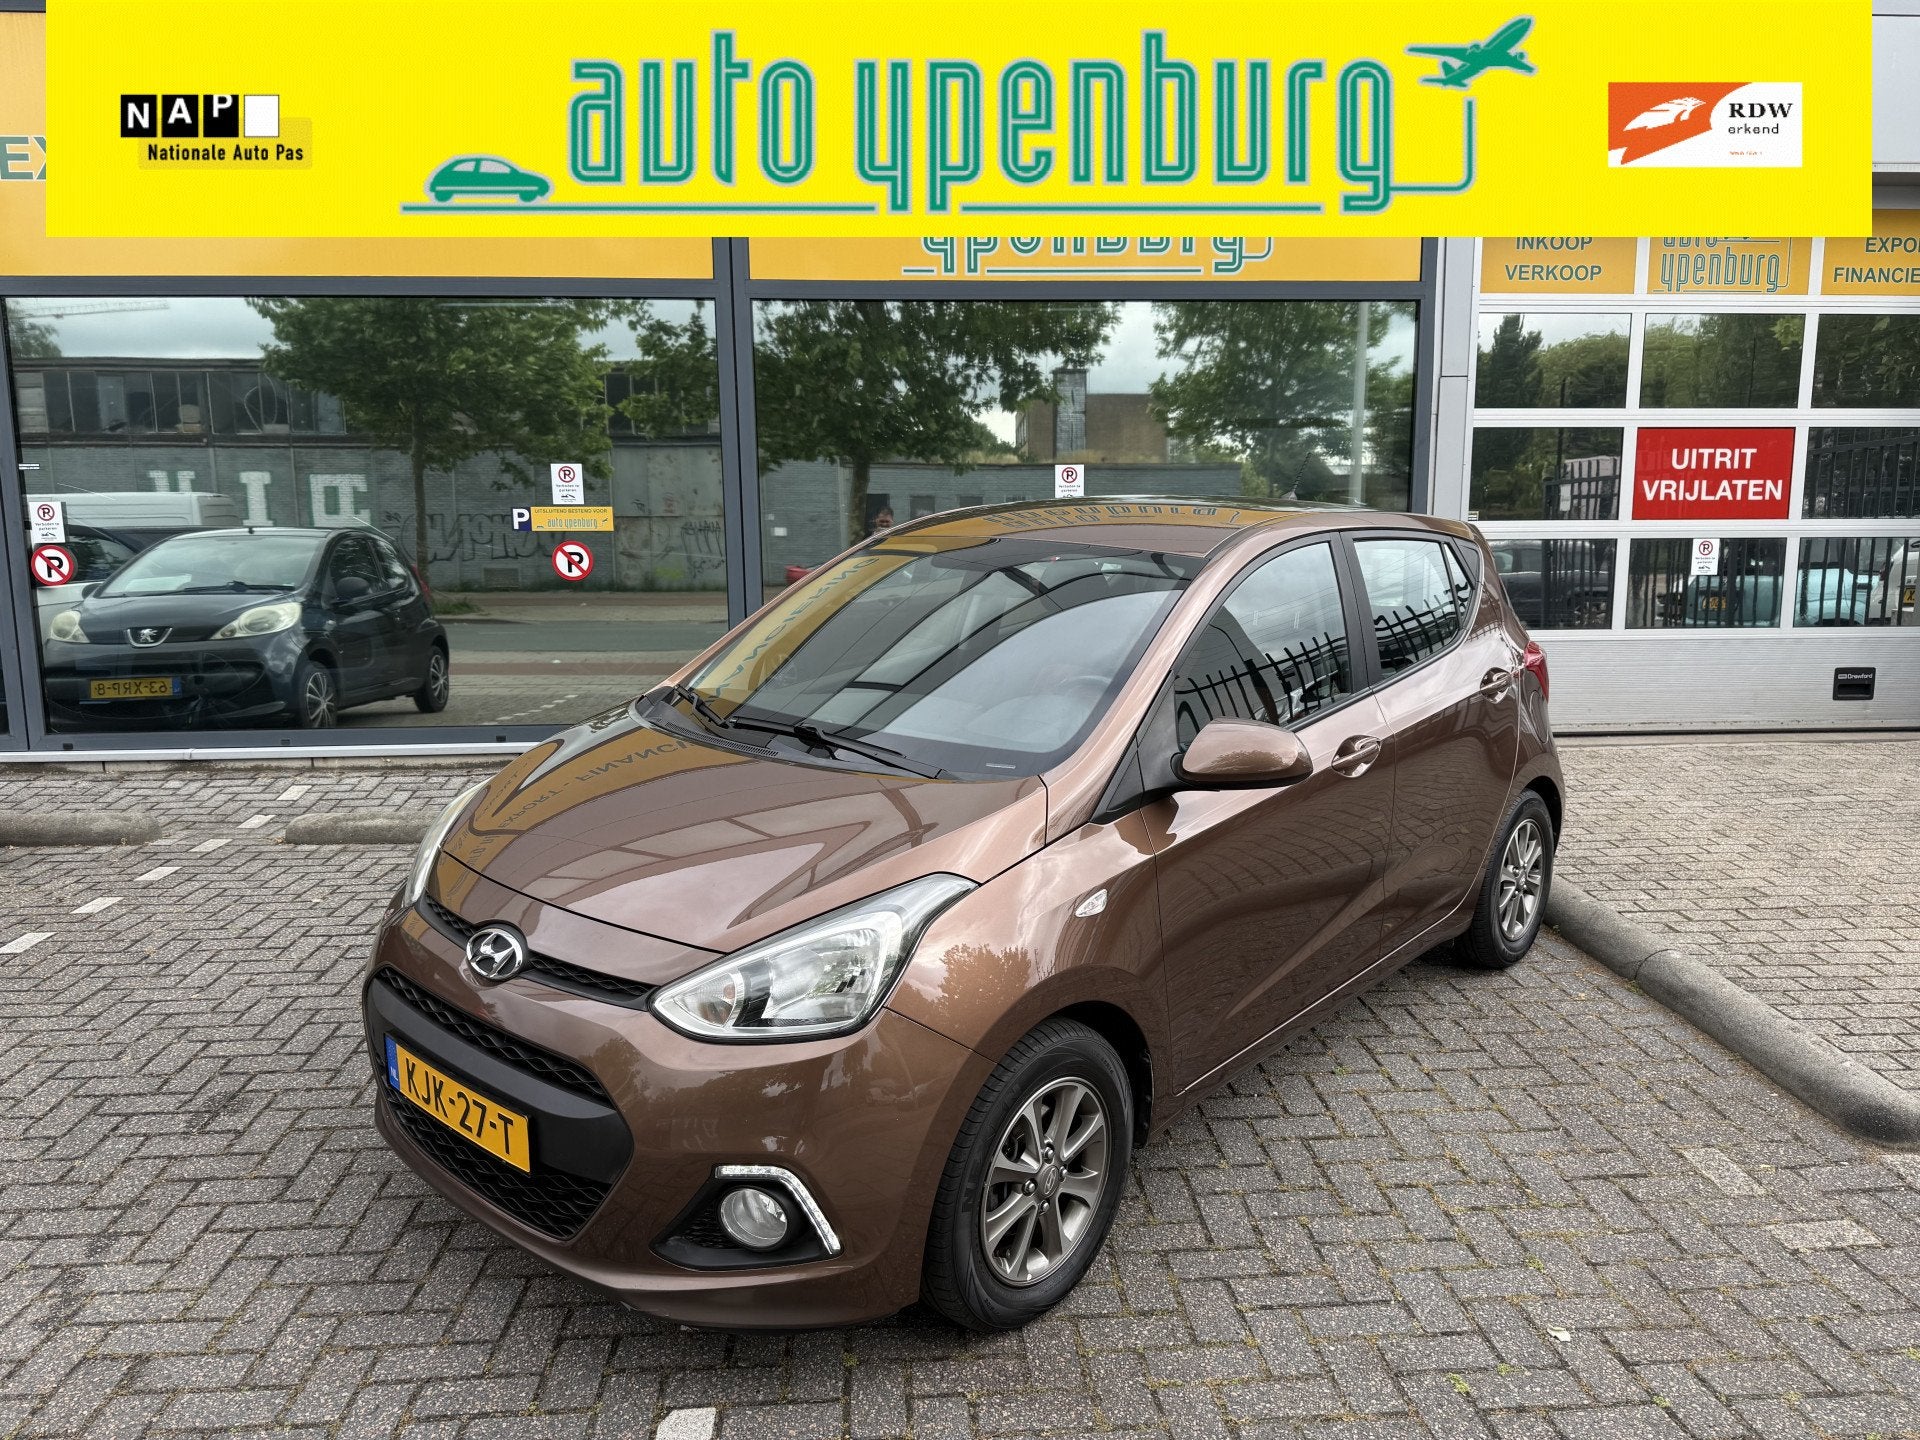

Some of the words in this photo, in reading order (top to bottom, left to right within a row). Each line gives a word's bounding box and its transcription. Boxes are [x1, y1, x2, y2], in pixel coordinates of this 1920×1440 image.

[1516, 237, 1593, 250] INKOOP
[1865, 237, 1920, 253] EXPO
[1505, 264, 1602, 281] VERKOOP
[1661, 246, 1780, 293] ypenburg
[1671, 448, 1757, 470] UITRIT
[1642, 479, 1783, 501] VRIJLATEN
[547, 517, 563, 528] auto
[406, 1057, 514, 1155] KJK-27-T
